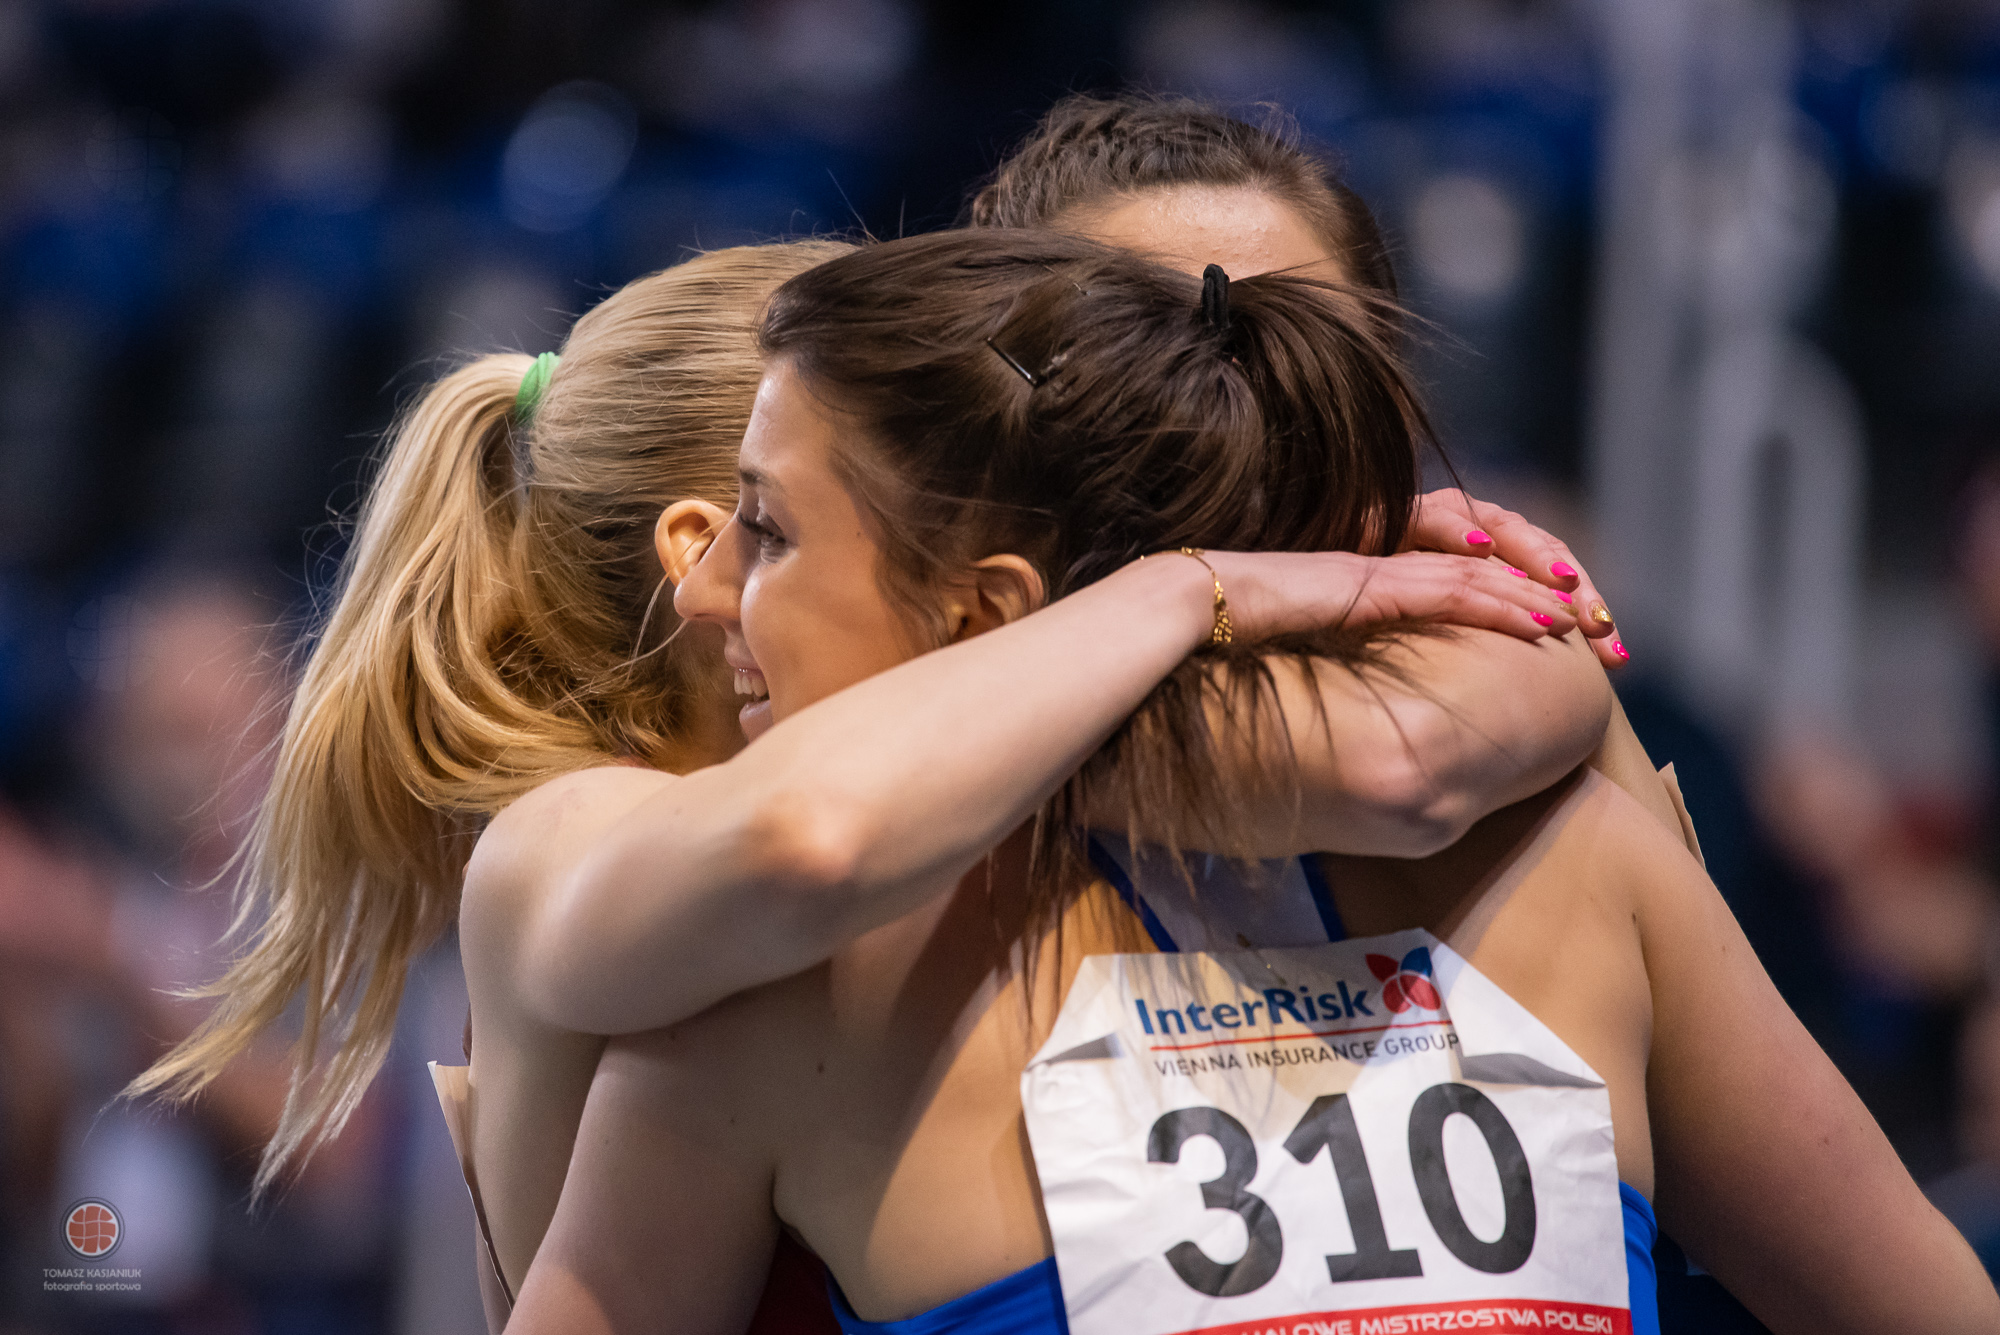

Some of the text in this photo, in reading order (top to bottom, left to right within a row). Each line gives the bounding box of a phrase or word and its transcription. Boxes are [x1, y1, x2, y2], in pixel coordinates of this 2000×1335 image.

[1135, 980, 1375, 1035] InterRisk
[1154, 1031, 1459, 1077] VIENNA INSURANCE GROUP
[1146, 1082, 1537, 1297] 310
[1360, 1308, 1542, 1335] MISTRZOSTWA
[1544, 1309, 1614, 1335] POLSKI
